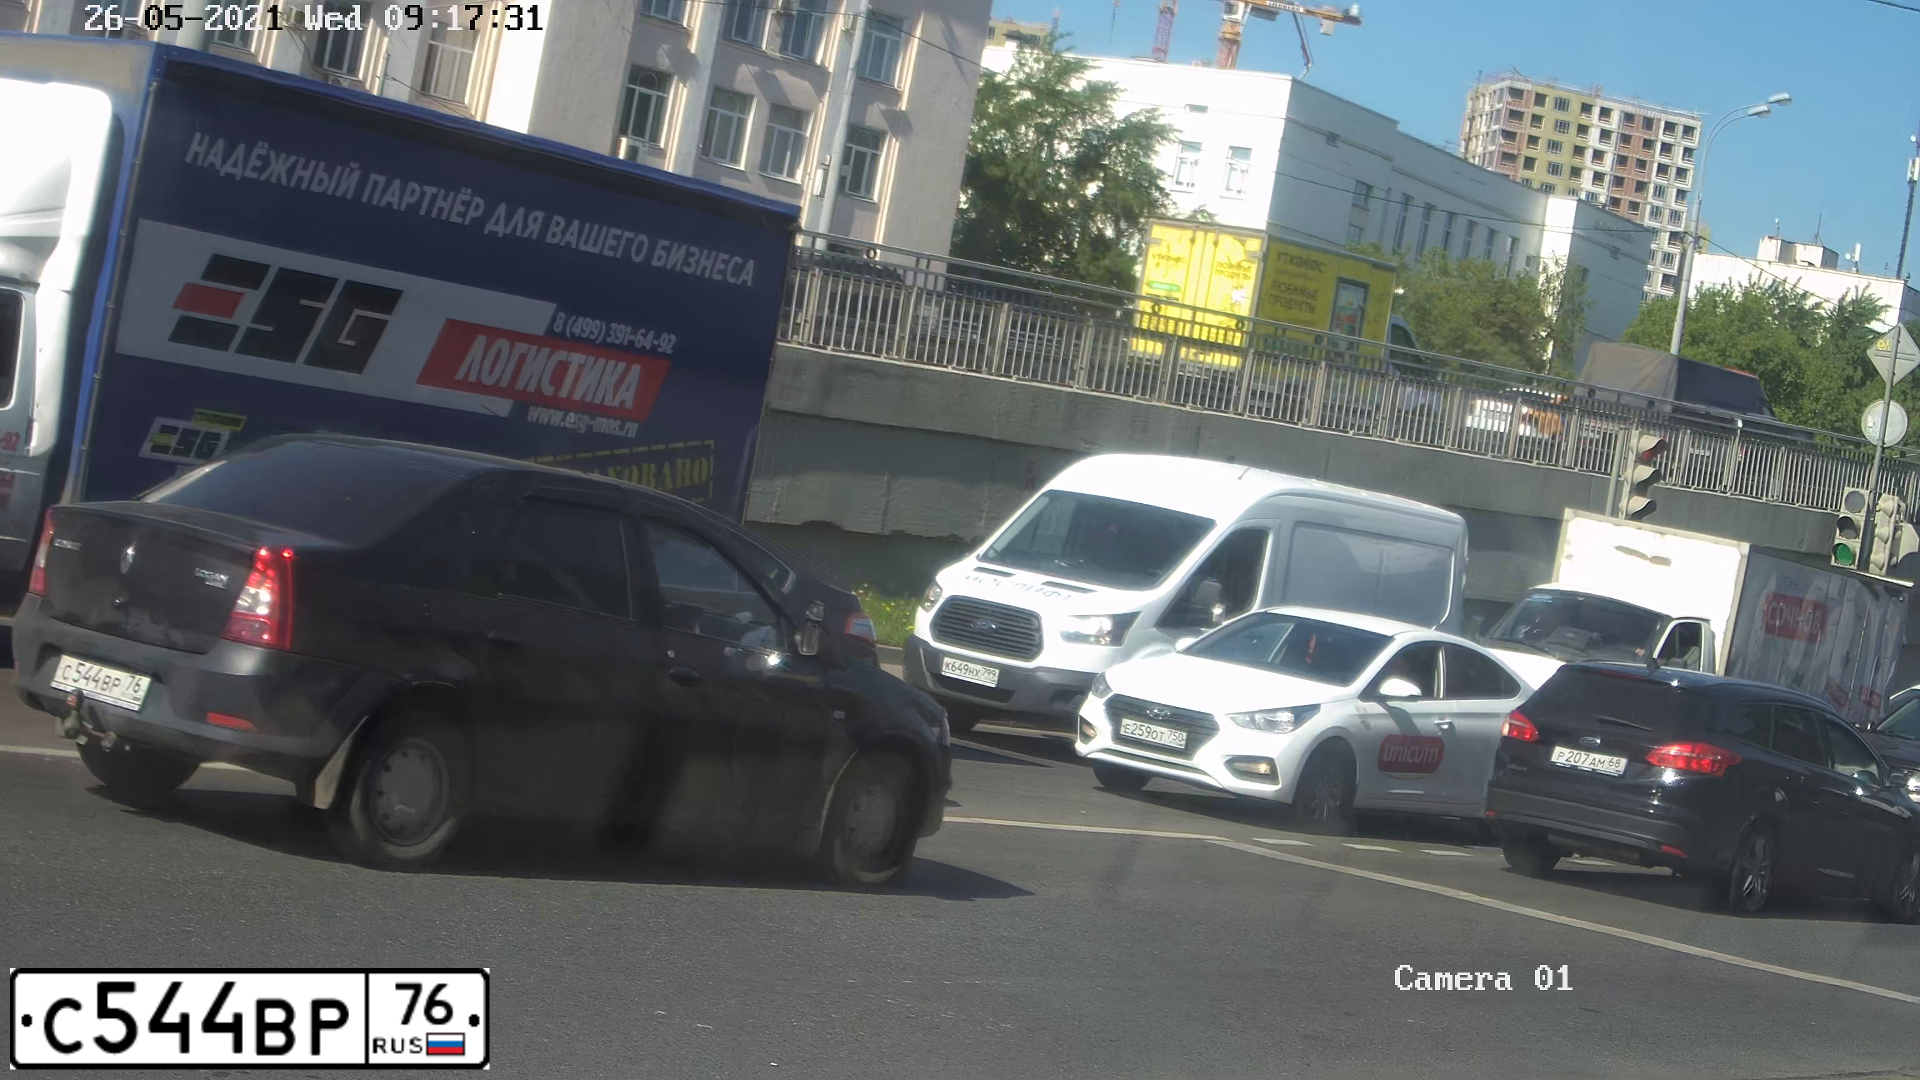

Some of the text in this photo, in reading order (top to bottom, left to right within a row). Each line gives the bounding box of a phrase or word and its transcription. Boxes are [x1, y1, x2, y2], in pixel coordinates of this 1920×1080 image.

[184, 131, 755, 287] НАДЁЖНЫЙ ПАРТНЁР ДЛЯ ВАШЕГО БИЗНЕСА
[553, 312, 677, 355] 8 (499) 391-64-92
[454, 334, 641, 410] ЛОГИСТИКА
[62, 662, 142, 693] С544ВР 76
[1123, 723, 1184, 742] Е259ОТ 750
[1383, 739, 1439, 763] unicum
[1556, 750, 1621, 768] Р207АМ 68
